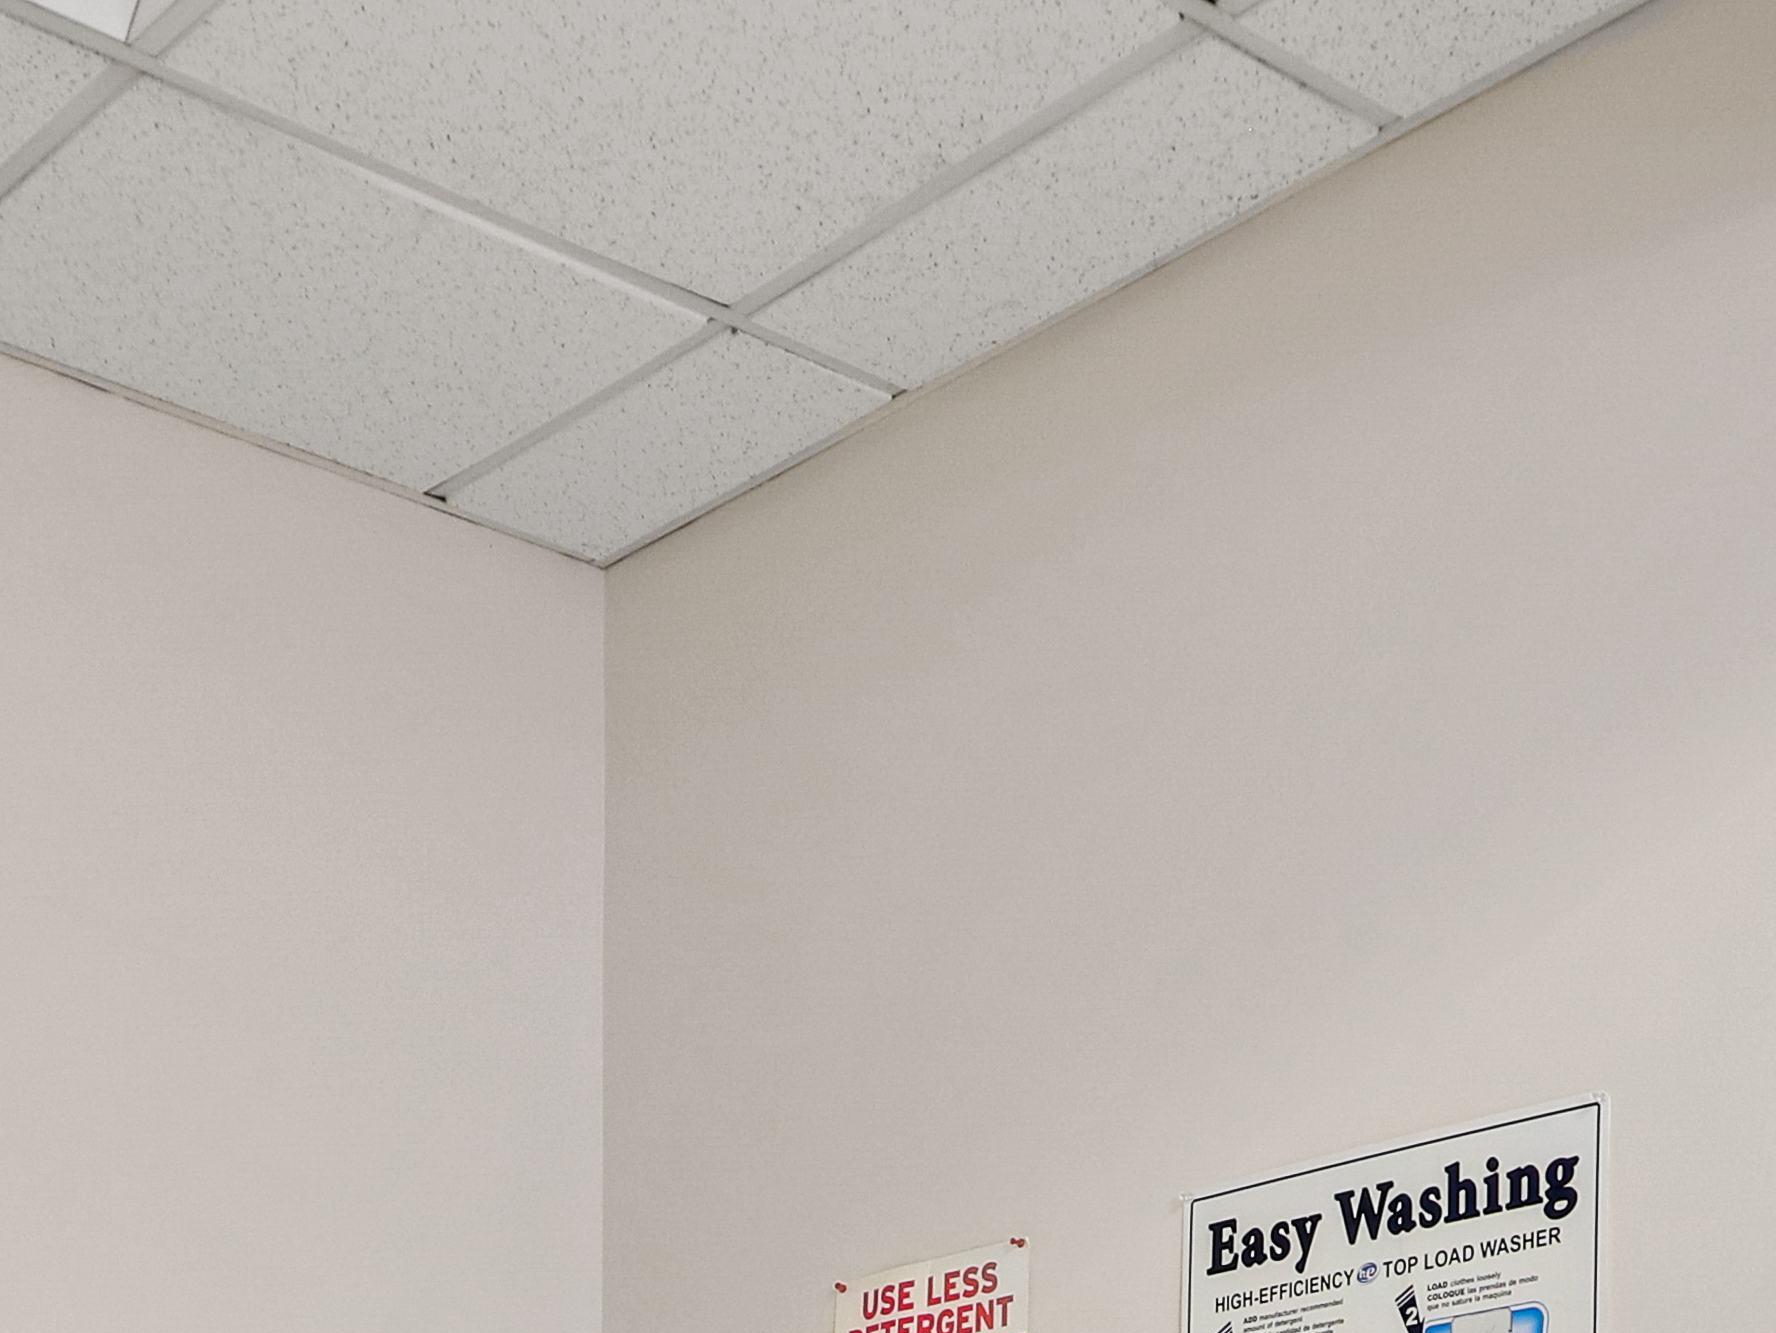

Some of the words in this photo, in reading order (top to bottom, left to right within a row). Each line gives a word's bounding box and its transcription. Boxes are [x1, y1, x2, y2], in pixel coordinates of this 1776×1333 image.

[1207, 1213, 1322, 1275] Easy
[1334, 1156, 1579, 1244] Washing
[863, 1280, 915, 1320] USE
[927, 1262, 997, 1306] LESS
[1215, 1269, 1355, 1313] HIGH-EFFICIENCY
[1384, 1256, 1418, 1277] TOP
[1425, 1245, 1474, 1270] LOAD
[1480, 1227, 1561, 1258] WASHER
[1406, 1307, 1418, 1325] 2
